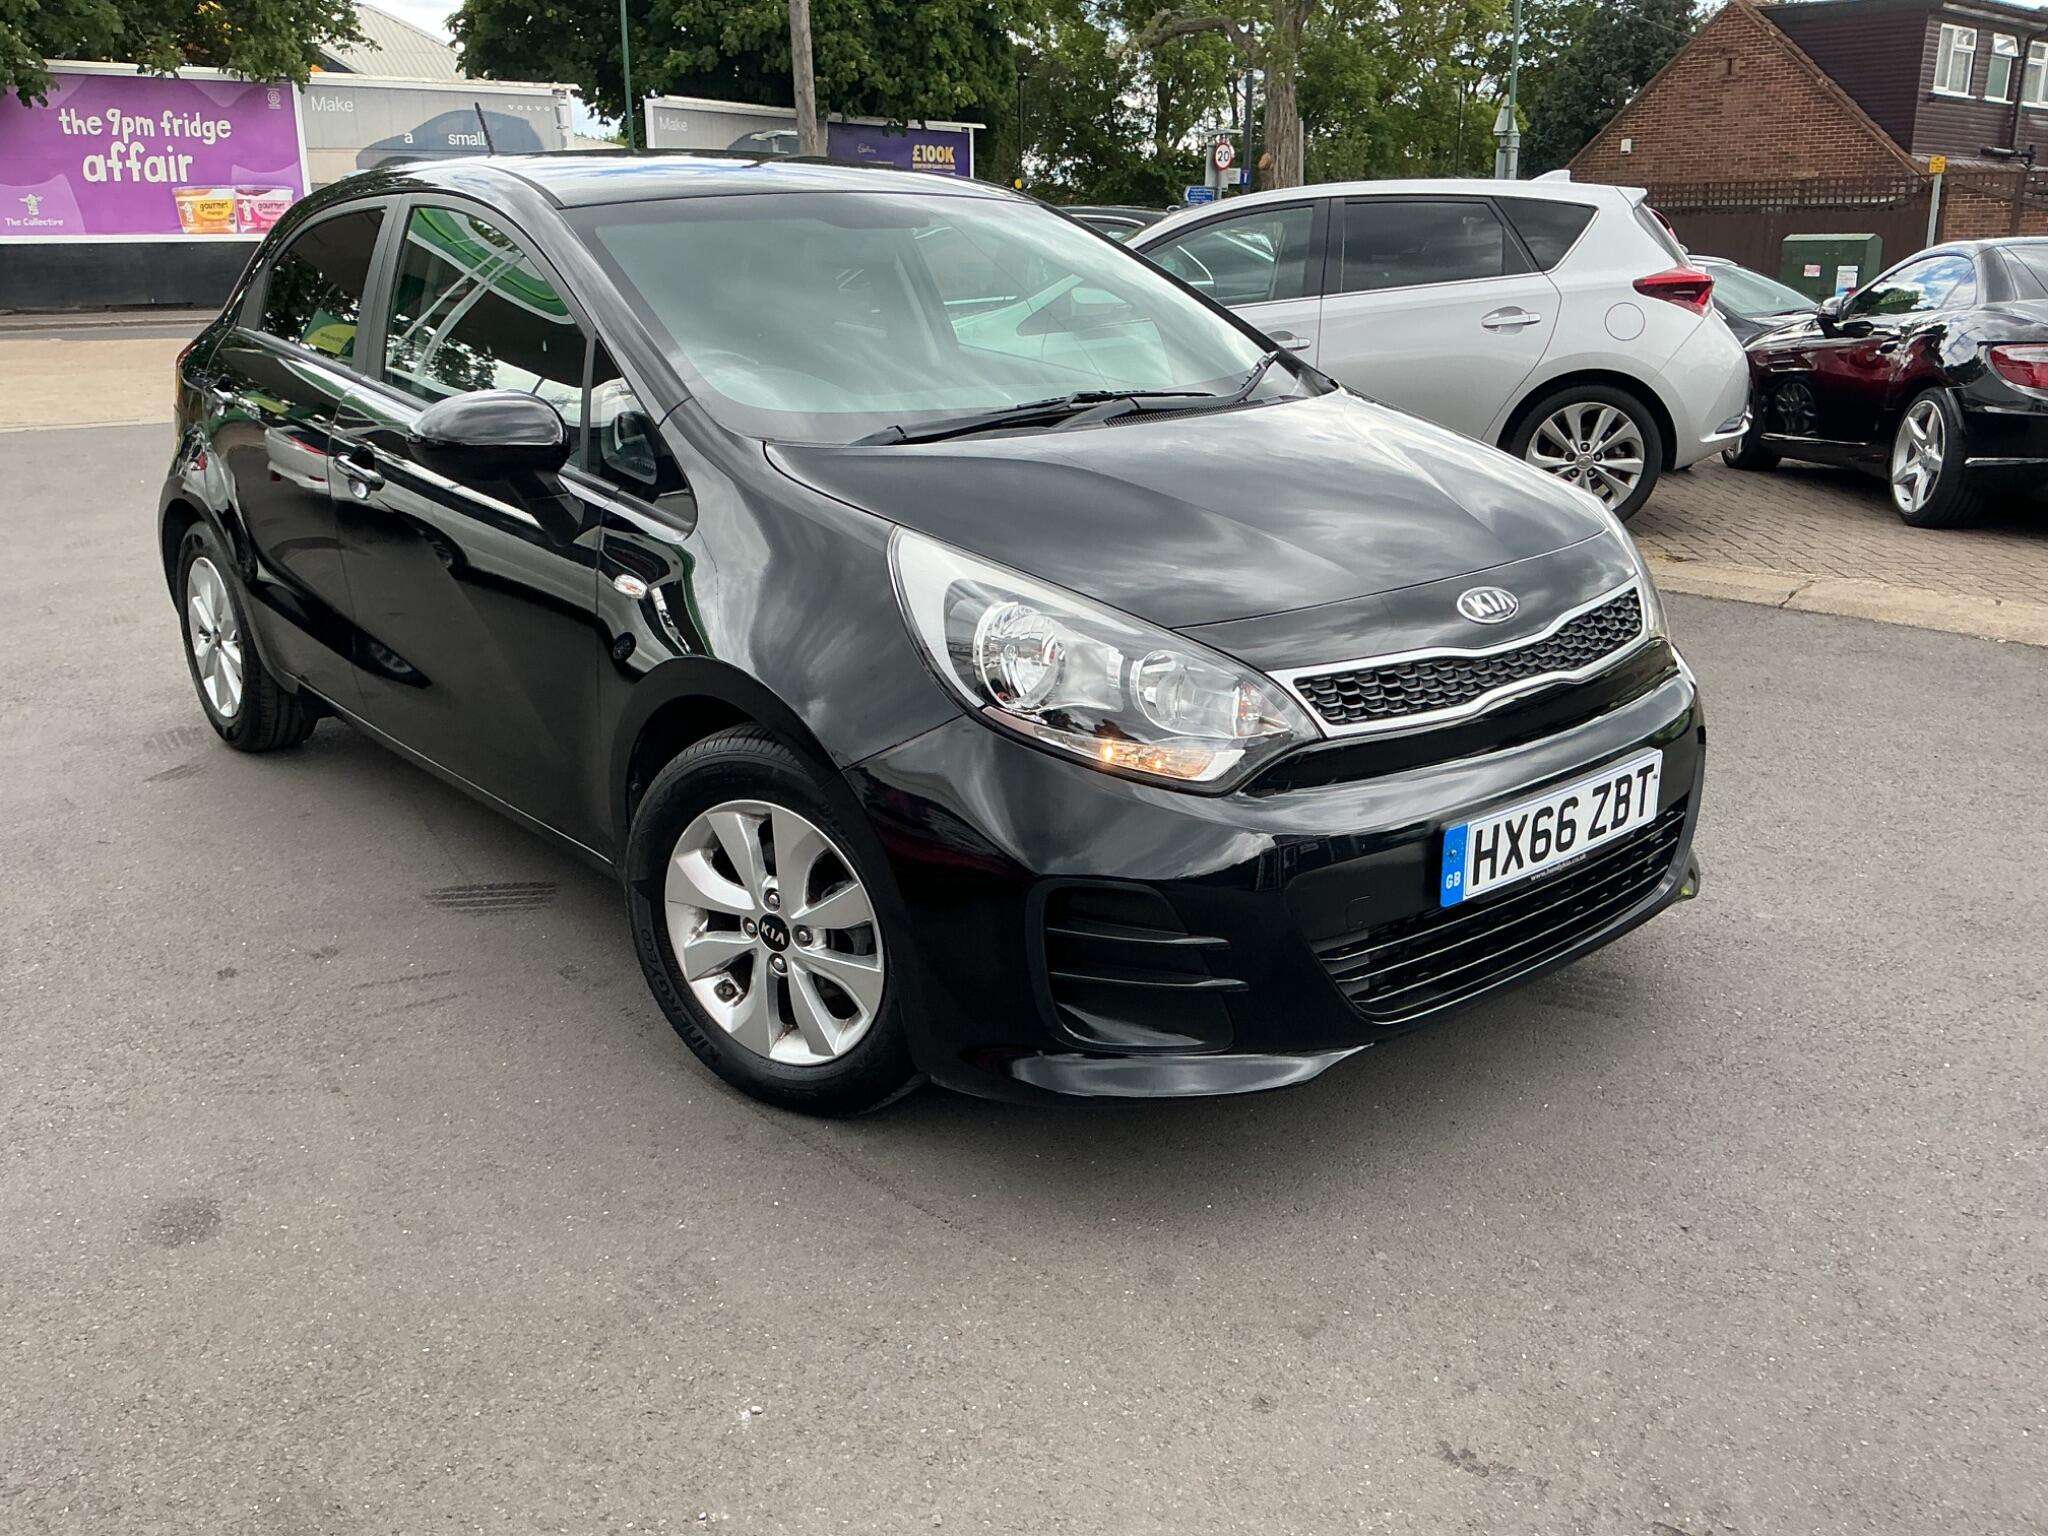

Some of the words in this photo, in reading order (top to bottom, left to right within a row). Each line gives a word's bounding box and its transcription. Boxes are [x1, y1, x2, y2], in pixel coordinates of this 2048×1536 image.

[311, 97, 354, 112] Make
[58, 108, 103, 136] the
[106, 108, 155, 143] 9pm
[160, 110, 232, 145] fridge
[659, 116, 688, 131] Make
[404, 132, 413, 144] a
[448, 132, 487, 146] small
[82, 141, 193, 182] affair
[912, 144, 955, 163] £100K
[1218, 150, 1229, 161] 20
[5, 217, 21, 226] The
[23, 217, 64, 226] Collective
[1464, 590, 1515, 617] KIA
[1473, 796, 1580, 886] HX66
[1587, 763, 1655, 841] ZBT
[1446, 870, 1461, 890] GB
[761, 921, 785, 945] KIA
